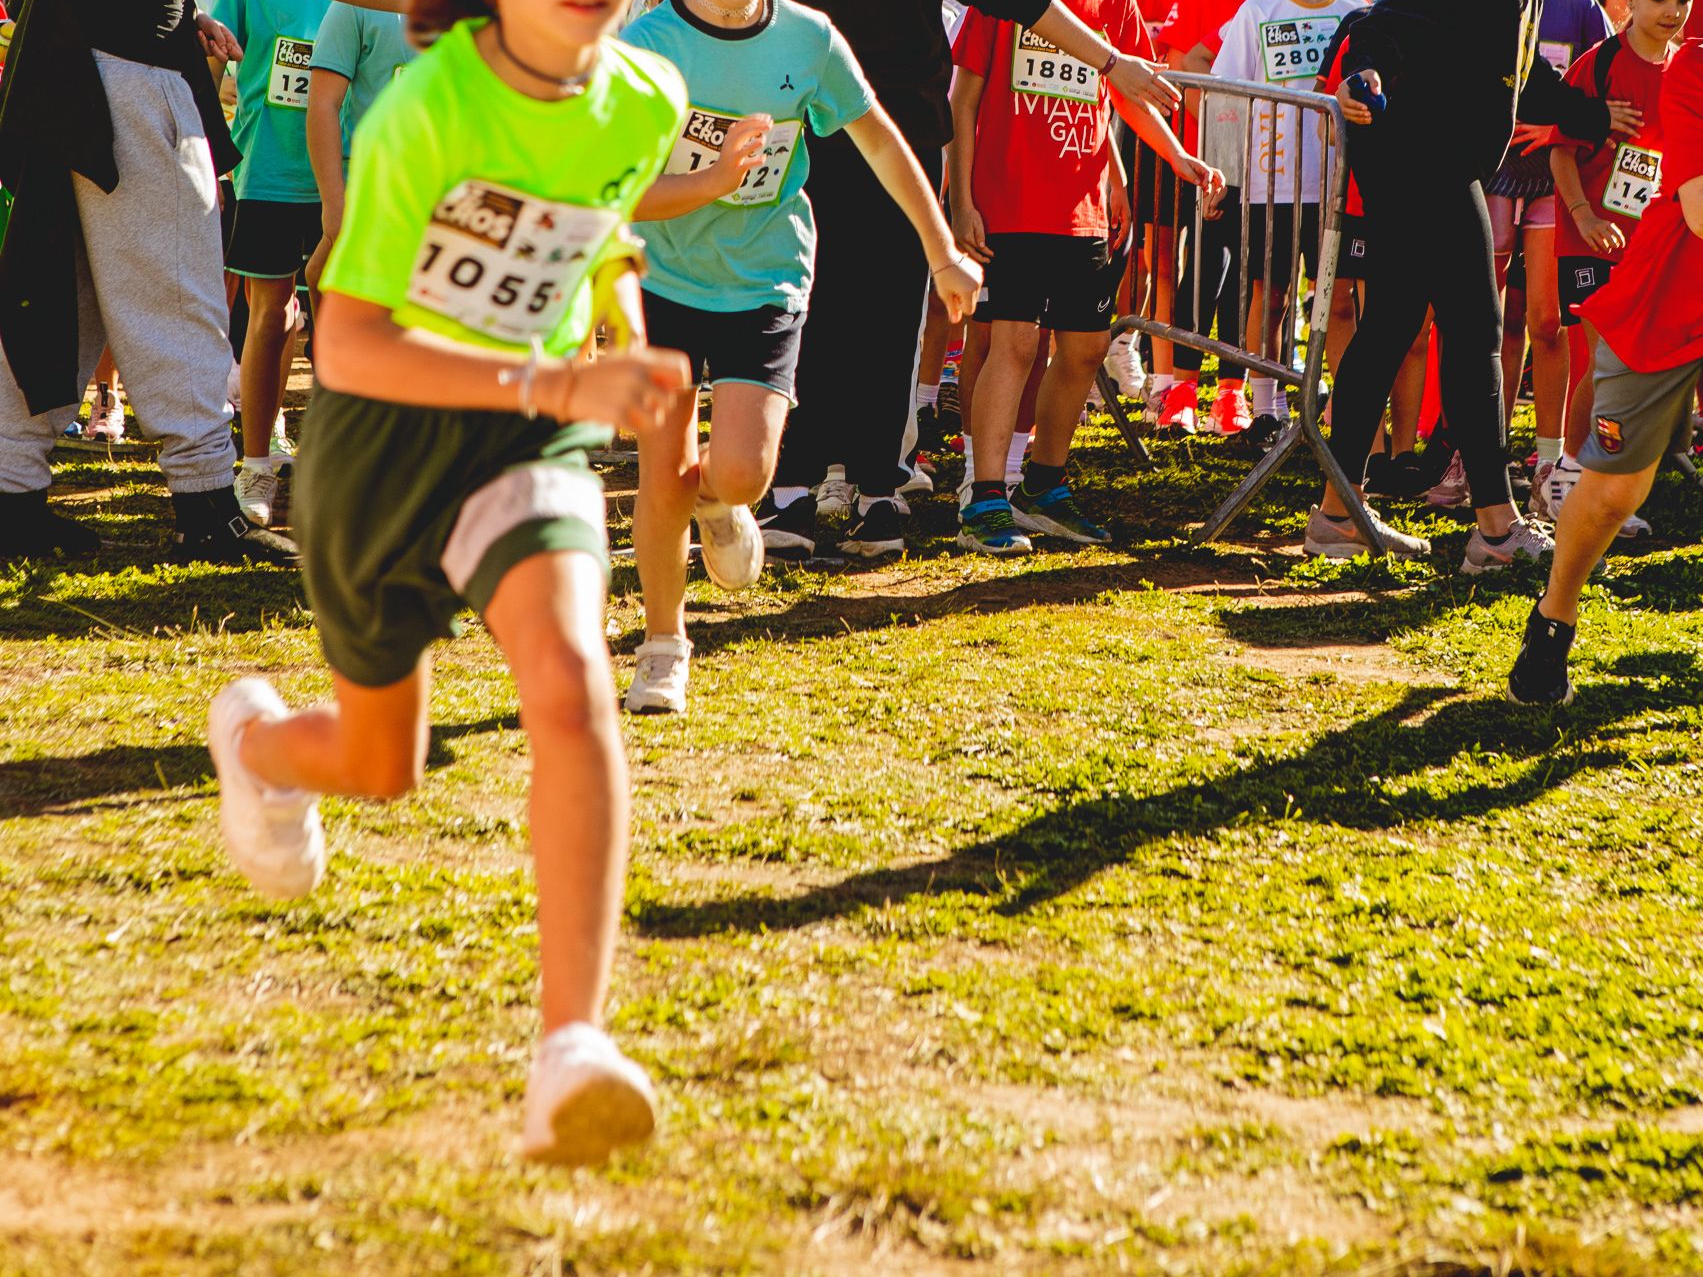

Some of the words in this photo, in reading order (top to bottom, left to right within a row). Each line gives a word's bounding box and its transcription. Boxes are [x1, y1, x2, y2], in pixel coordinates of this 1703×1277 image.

[1022, 31, 1057, 49] CRO
[1268, 31, 1297, 44] CROS
[279, 52, 311, 66] CROS
[1026, 58, 1088, 85] 1885
[1014, 90, 1094, 125] MAA
[688, 124, 728, 146] CRO
[1622, 158, 1656, 177] CROS
[420, 243, 556, 314] 1055
